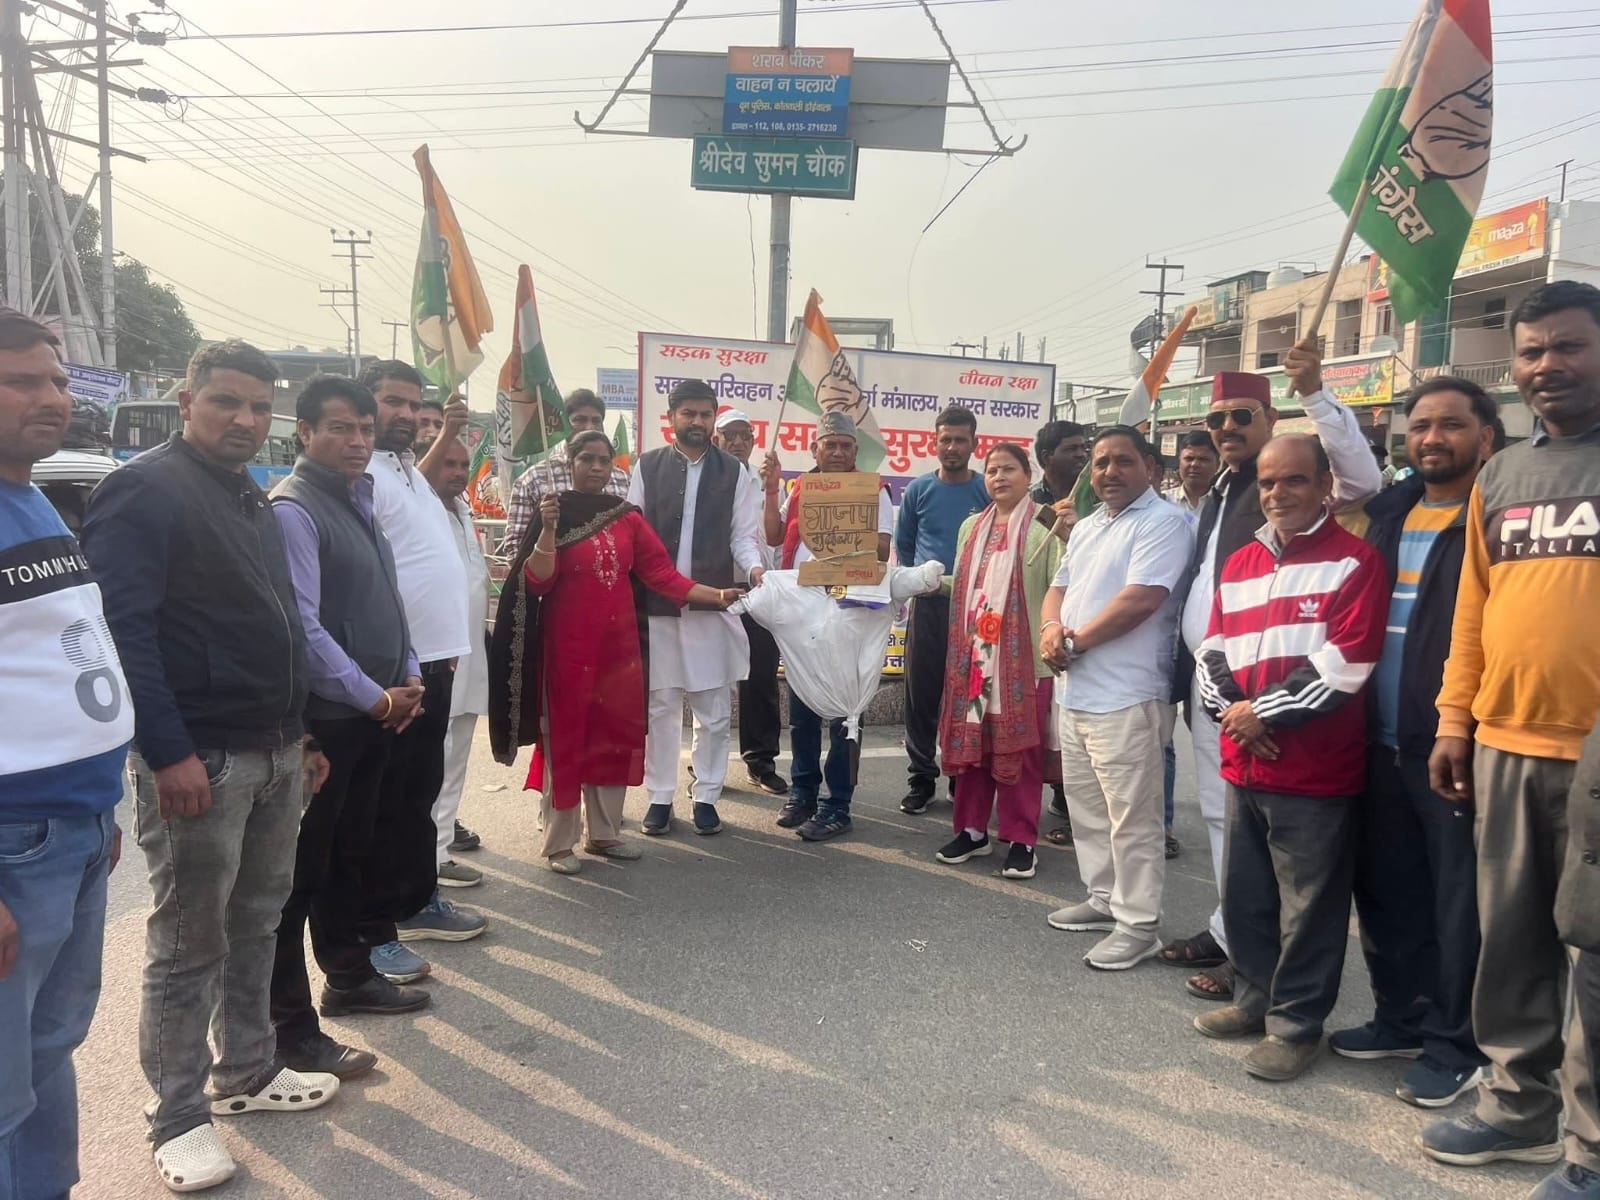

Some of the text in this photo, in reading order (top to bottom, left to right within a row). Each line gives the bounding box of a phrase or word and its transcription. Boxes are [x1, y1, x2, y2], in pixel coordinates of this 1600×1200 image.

[789, 50, 825, 69] पीकर
[735, 75, 840, 93] वाहन न चलायें
[754, 122, 769, 131] 112,
[699, 141, 846, 182] श्रीदेव सुमन चौक
[1370, 163, 1436, 246] ांग्रेस
[1488, 221, 1524, 242] maaza
[659, 344, 769, 366] सड़क सुरक्षा
[601, 384, 625, 394] MBA
[959, 369, 1039, 390] जीवन रक्षा
[881, 386, 942, 413] मंत्रालय,
[990, 399, 1041, 419] सरकार
[805, 480, 841, 492] maaza
[1500, 502, 1600, 542] FILA
[1501, 539, 1596, 556] ITALIA
